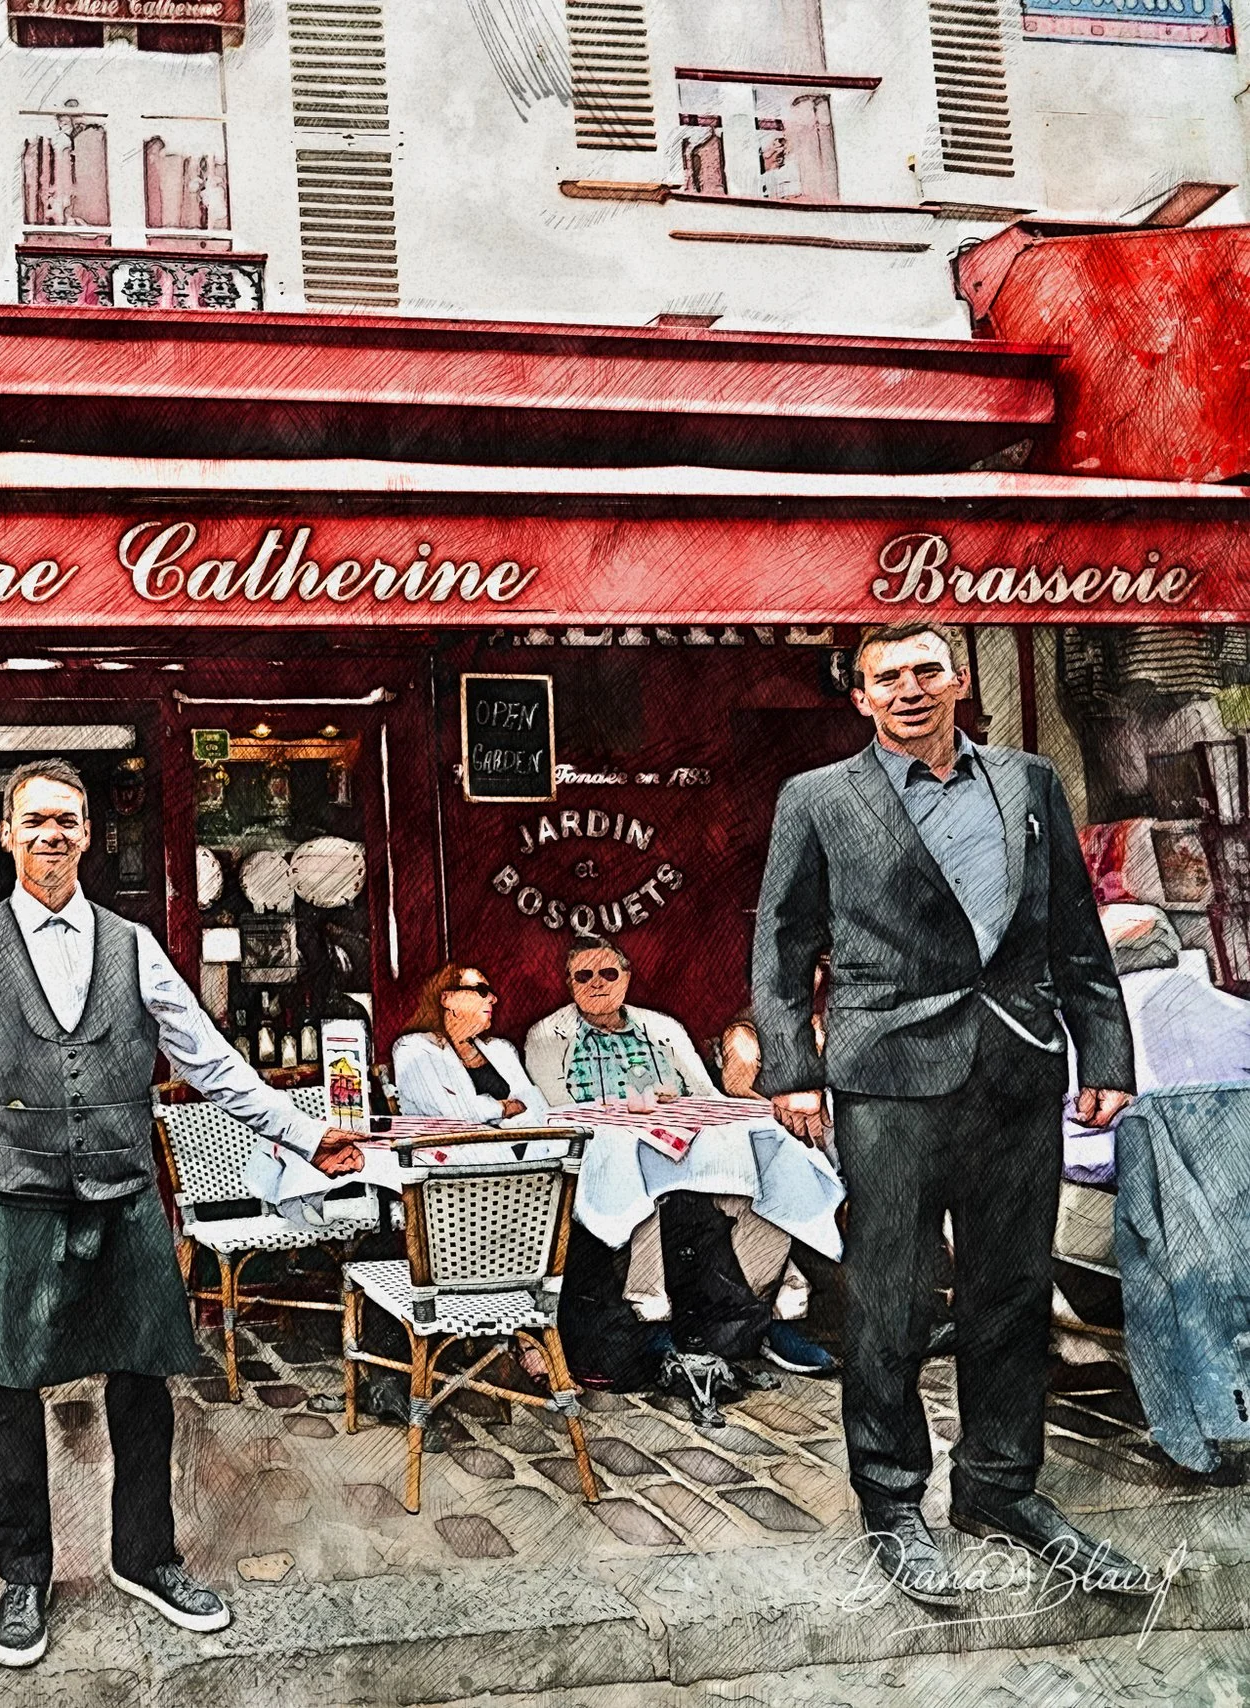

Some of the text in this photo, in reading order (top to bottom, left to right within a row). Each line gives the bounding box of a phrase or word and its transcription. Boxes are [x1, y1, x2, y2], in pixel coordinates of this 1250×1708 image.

[119, 521, 539, 602] Catherine
[872, 533, 1204, 604] Brasserie
[475, 700, 540, 731] OPEN
[472, 743, 543, 774] GARDEN
[635, 773, 660, 785] en
[518, 809, 655, 855] JARDIN
[575, 860, 599, 879] et
[492, 863, 684, 938] BOSQUETS
